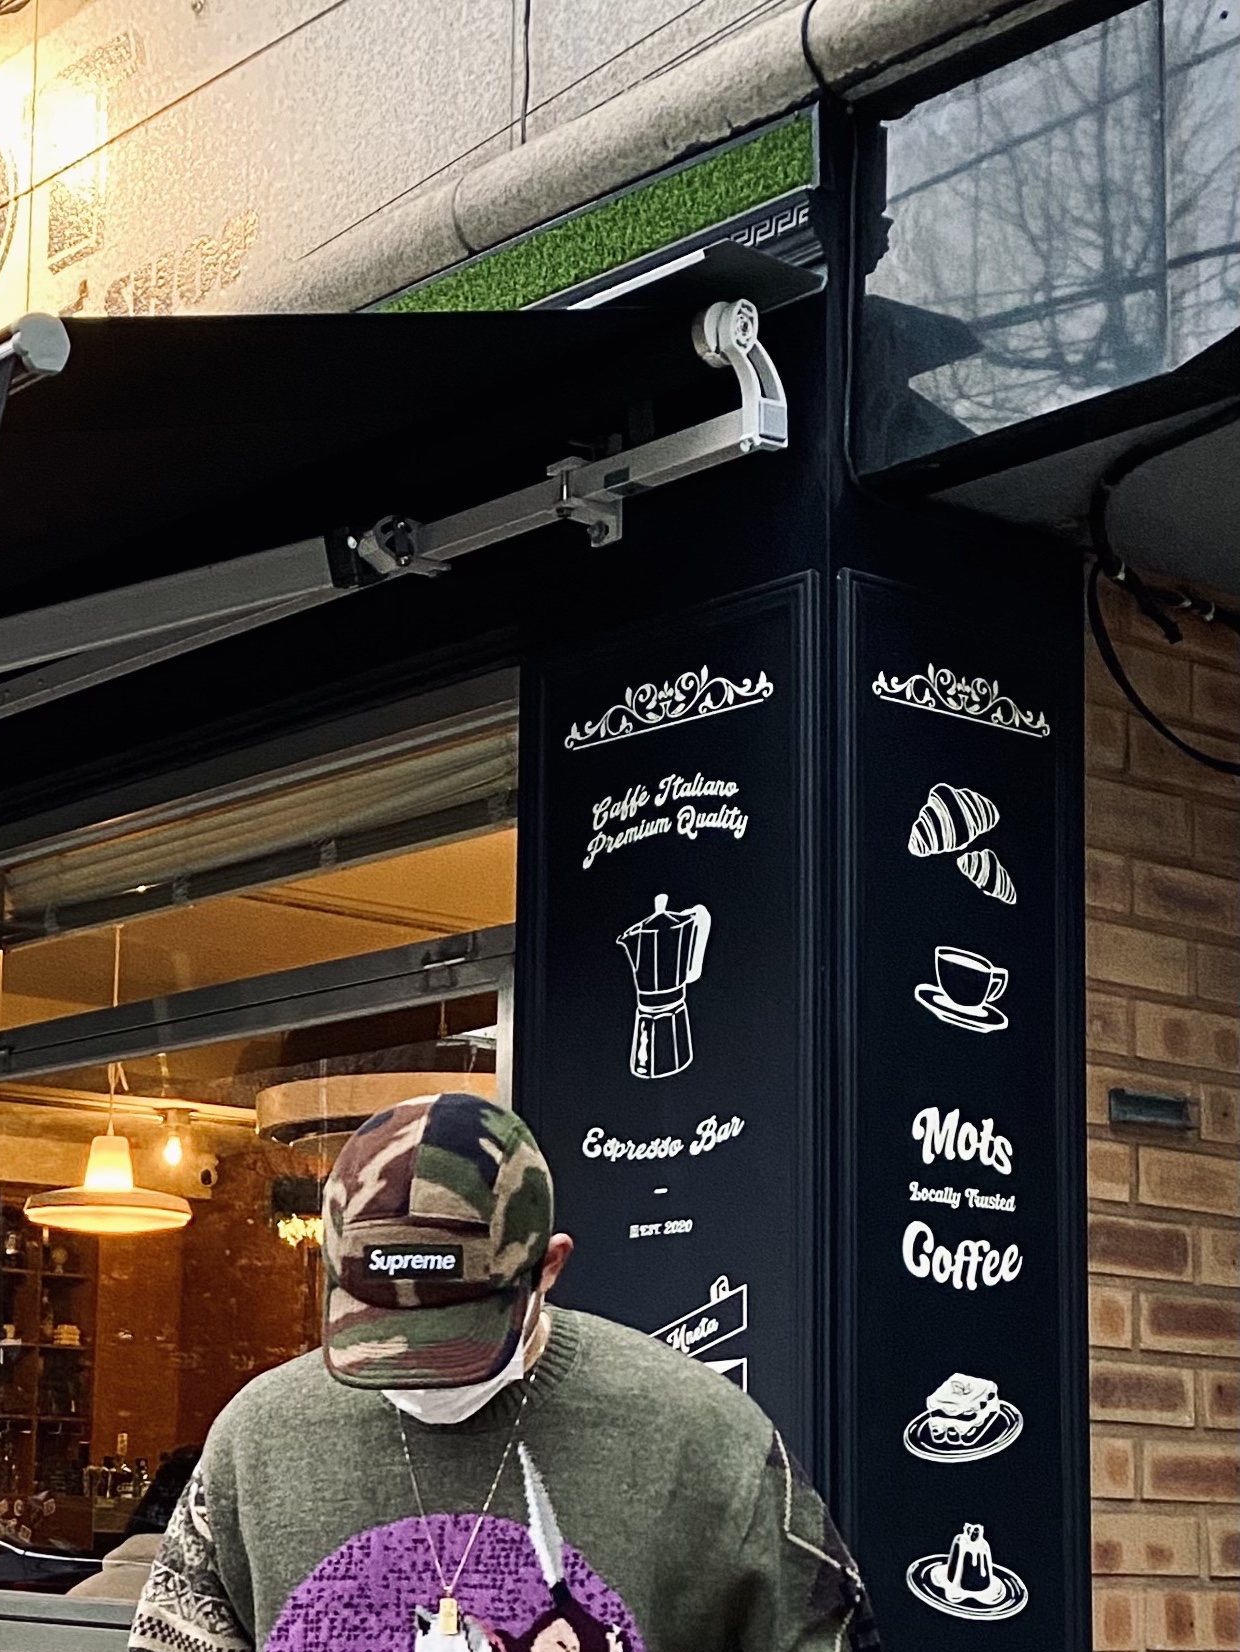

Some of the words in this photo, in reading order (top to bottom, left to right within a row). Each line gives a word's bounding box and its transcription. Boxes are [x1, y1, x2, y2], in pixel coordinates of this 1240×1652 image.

[655, 772, 739, 806] Italiano
[583, 817, 672, 869] Premium
[677, 804, 749, 839] Quality
[582, 1127, 684, 1162] Espresso
[689, 1115, 745, 1155] Bar
[912, 1106, 1013, 1175] Mots
[909, 1181, 961, 1209] Locally
[964, 1188, 1016, 1212] Trusted
[663, 1218, 693, 1234] 2020
[368, 1249, 456, 1275] Supreme
[902, 1220, 1023, 1291] Coffee
